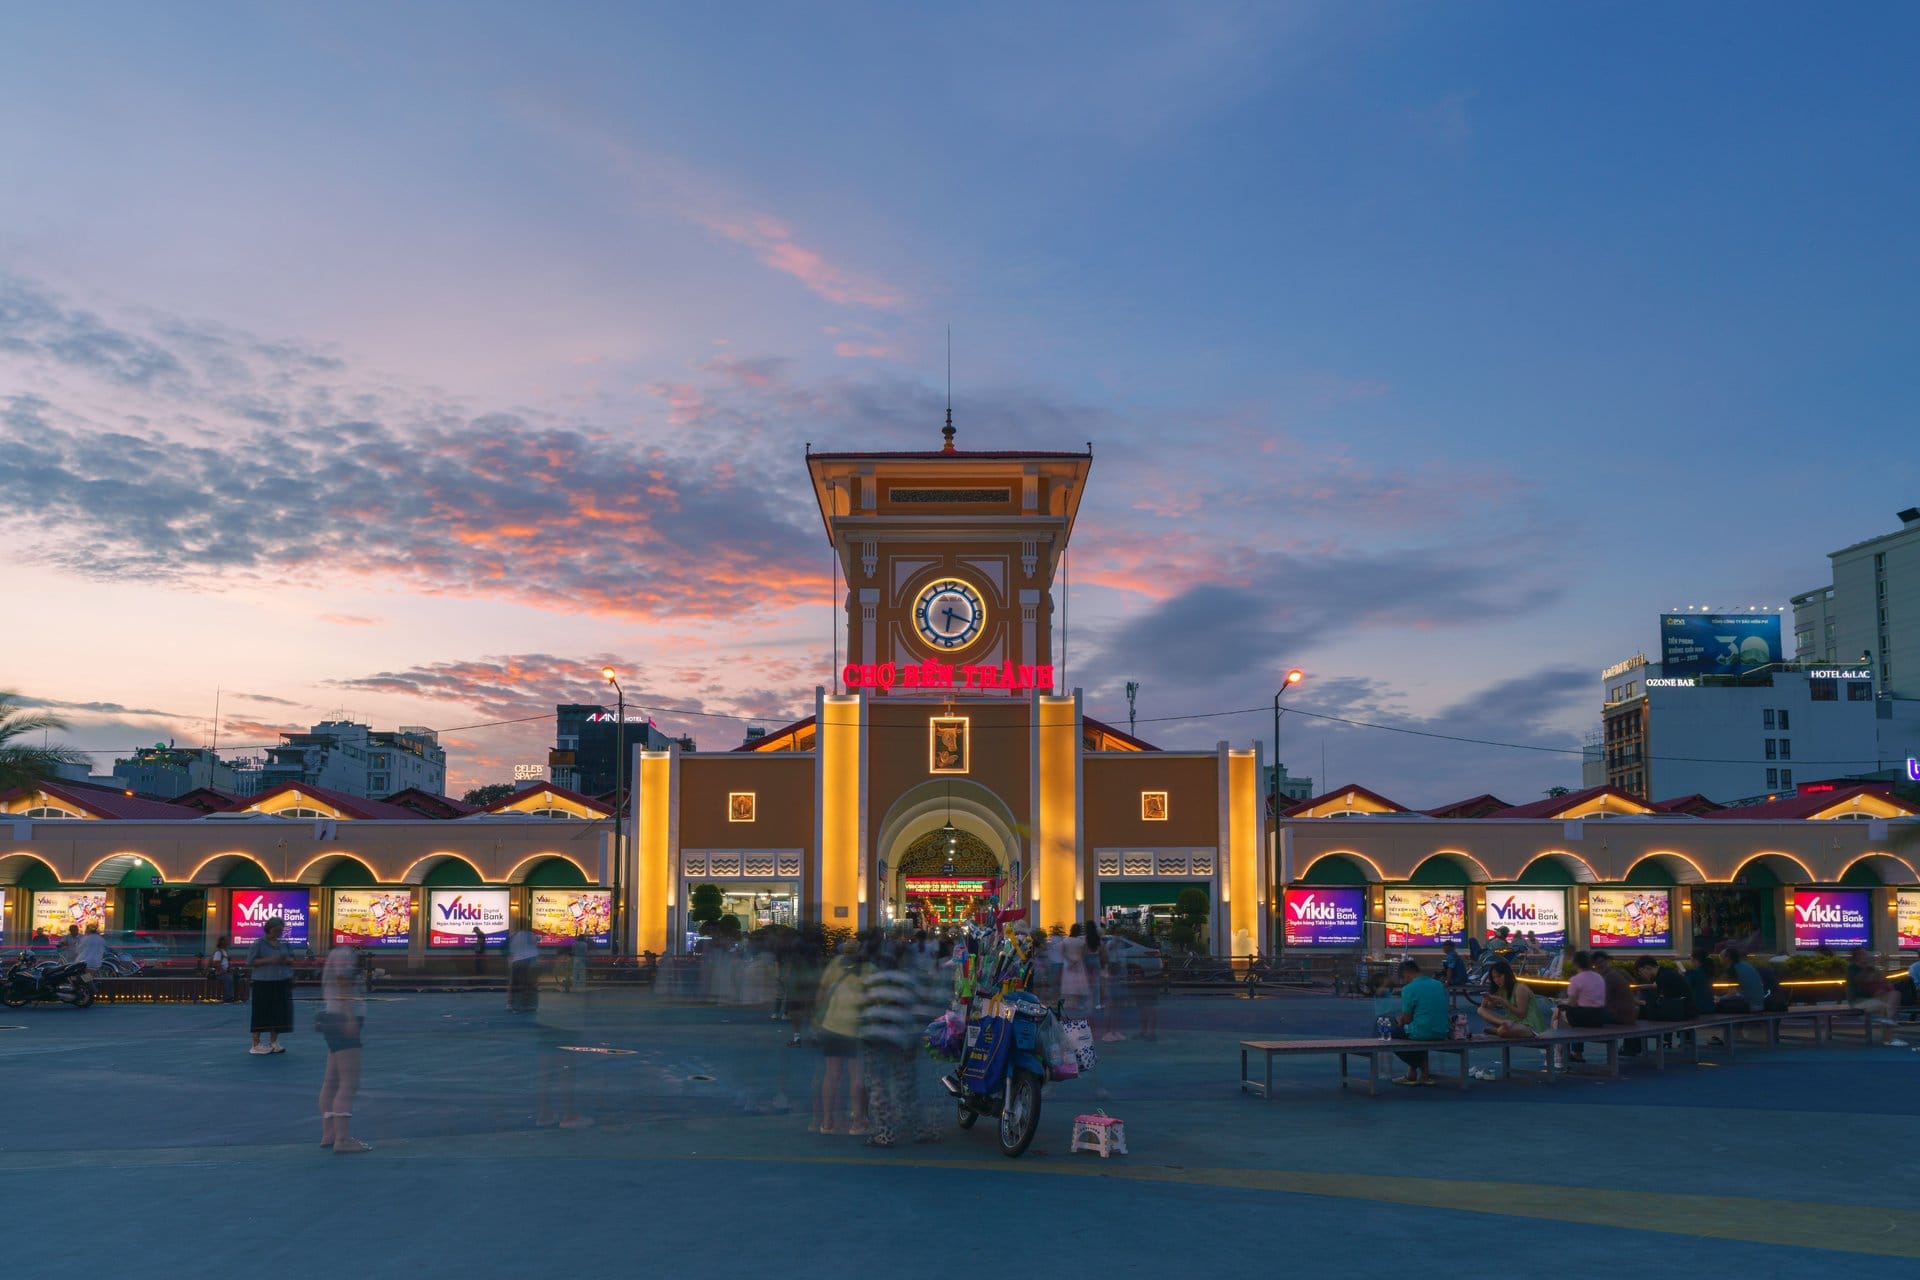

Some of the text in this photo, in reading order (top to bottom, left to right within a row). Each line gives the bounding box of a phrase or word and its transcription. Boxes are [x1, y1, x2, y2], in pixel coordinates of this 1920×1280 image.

[943, 582, 957, 590] 12
[916, 607, 925, 618] 9
[975, 609, 983, 620] 3
[944, 639, 954, 648] 6
[843, 656, 1055, 691] CHỢ BẾN THÀNH
[1811, 670, 1870, 679] HOTEL du LAC
[1645, 678, 1696, 687] OZONE BAR
[238, 895, 283, 920] Vikki
[437, 895, 481, 920] Vikki
[1289, 894, 1335, 919] Vikki
[1491, 895, 1536, 919] Vikki
[1795, 896, 1840, 922] Vikki
